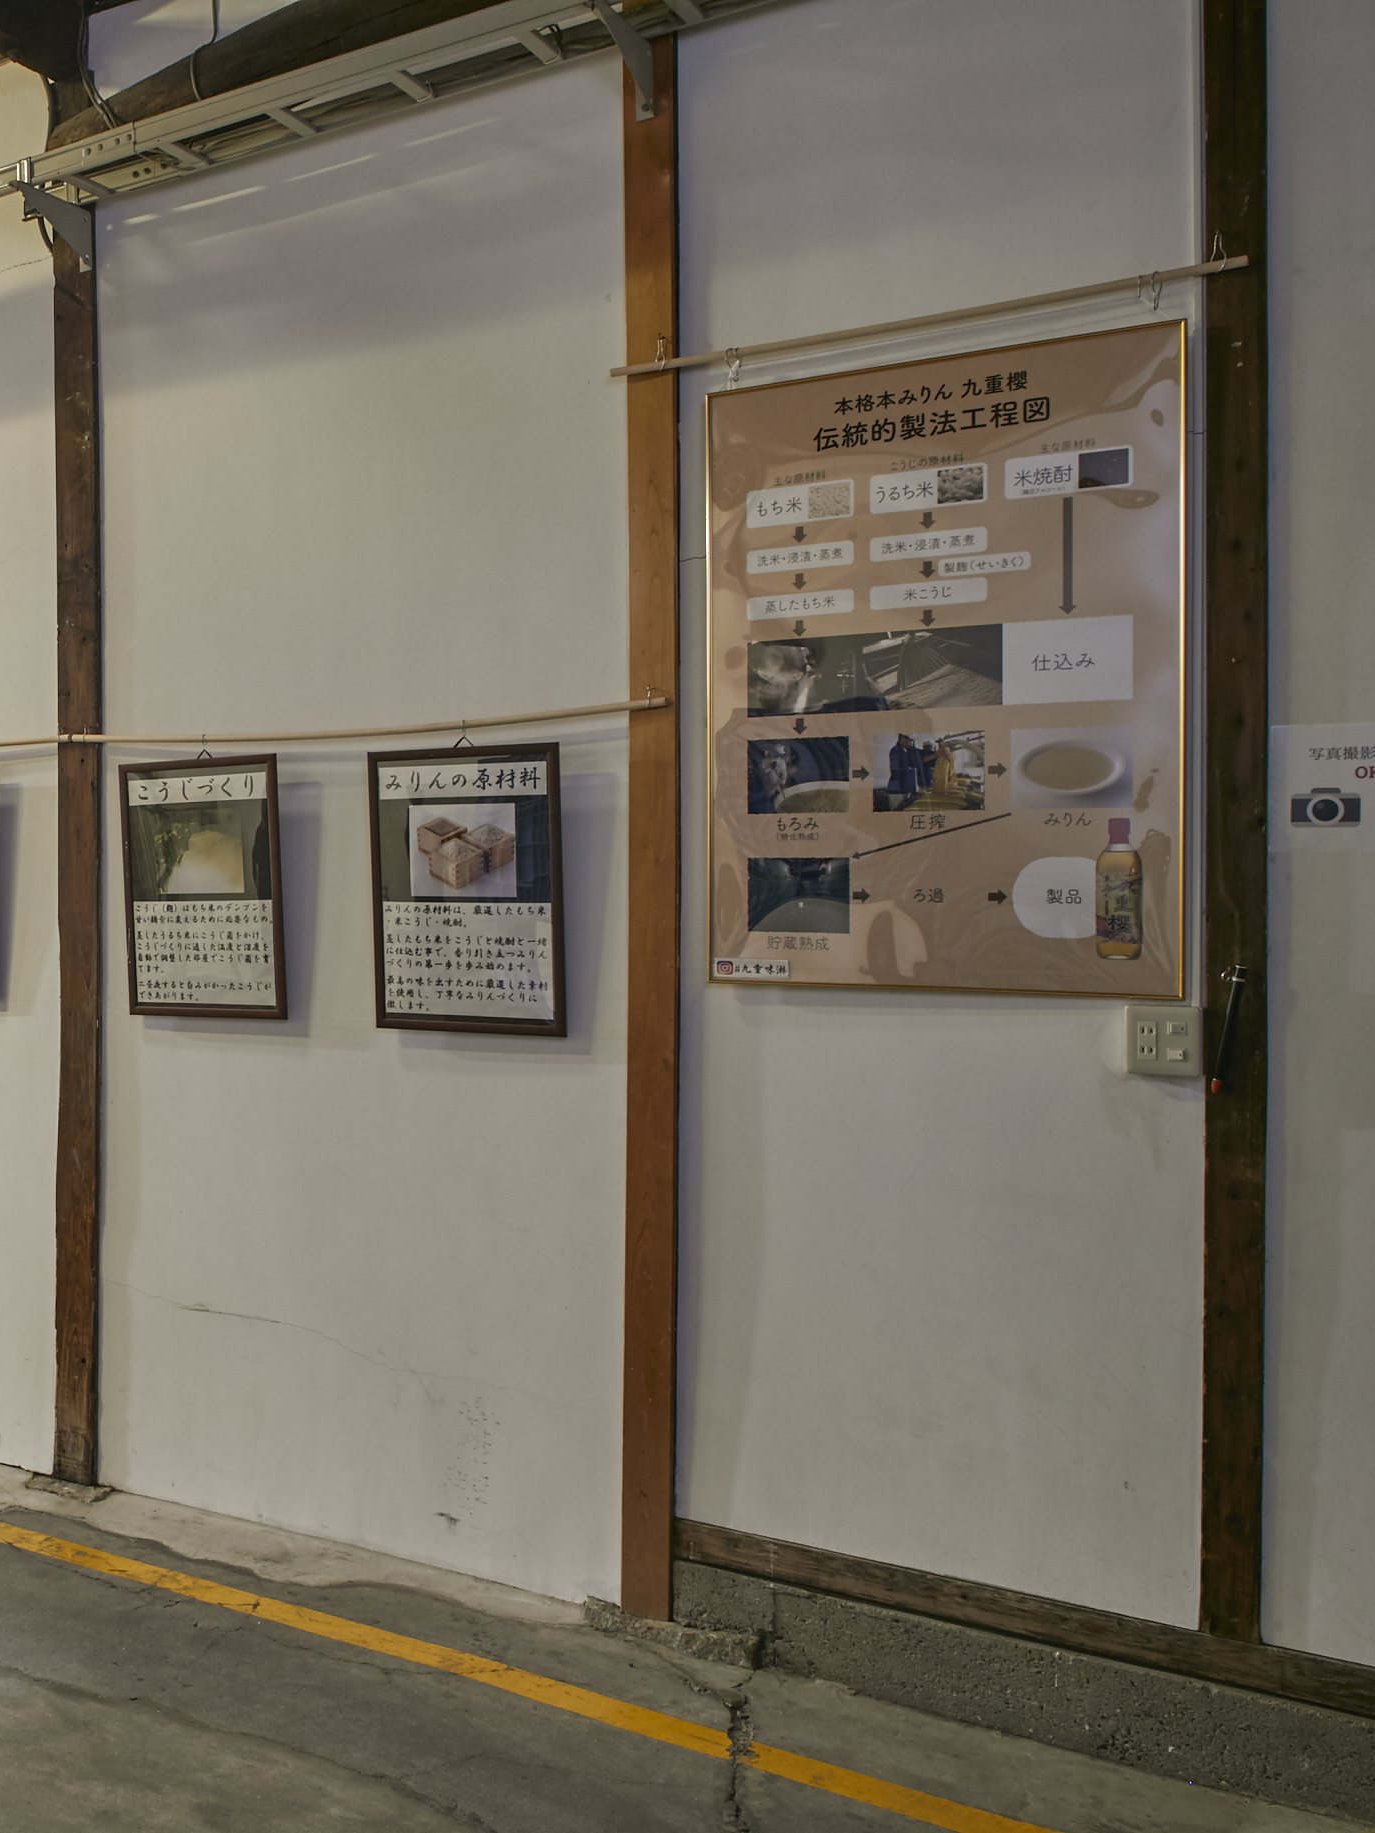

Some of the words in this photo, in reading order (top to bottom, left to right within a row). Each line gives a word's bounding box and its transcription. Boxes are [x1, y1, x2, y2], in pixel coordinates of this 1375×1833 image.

[834, 384, 953, 416] 本格本みりん
[961, 370, 1028, 398] 九重櫻
[813, 396, 1051, 453] 伝統的製法工程図
[1040, 438, 1096, 453] 主な原材料
[890, 453, 964, 471] こうじの原材料
[774, 470, 827, 487] 主な原材料
[1014, 464, 1073, 487] 米焼酎
[876, 481, 934, 503] うるち米
[756, 497, 803, 517] もち米
[881, 534, 976, 555] 洗米・浸漬・蒸煮
[757, 548, 843, 567] 洗米・浸漬・蒸煮
[903, 585, 952, 602] 米こうじ
[765, 595, 835, 614] 蒸したもち米
[1031, 652, 1096, 673] 仕込み
[1309, 746, 1375, 760] 写真撮影
[138, 775, 254, 802] こうじづくり
[385, 767, 542, 793] みりんの原材料
[776, 816, 819, 832] もろみ
[909, 813, 946, 831] 圧搾
[1043, 811, 1092, 828] みりん
[912, 887, 944, 905] ろ過
[1045, 887, 1082, 905] 製品
[766, 935, 830, 953] 貯蔵熟成
